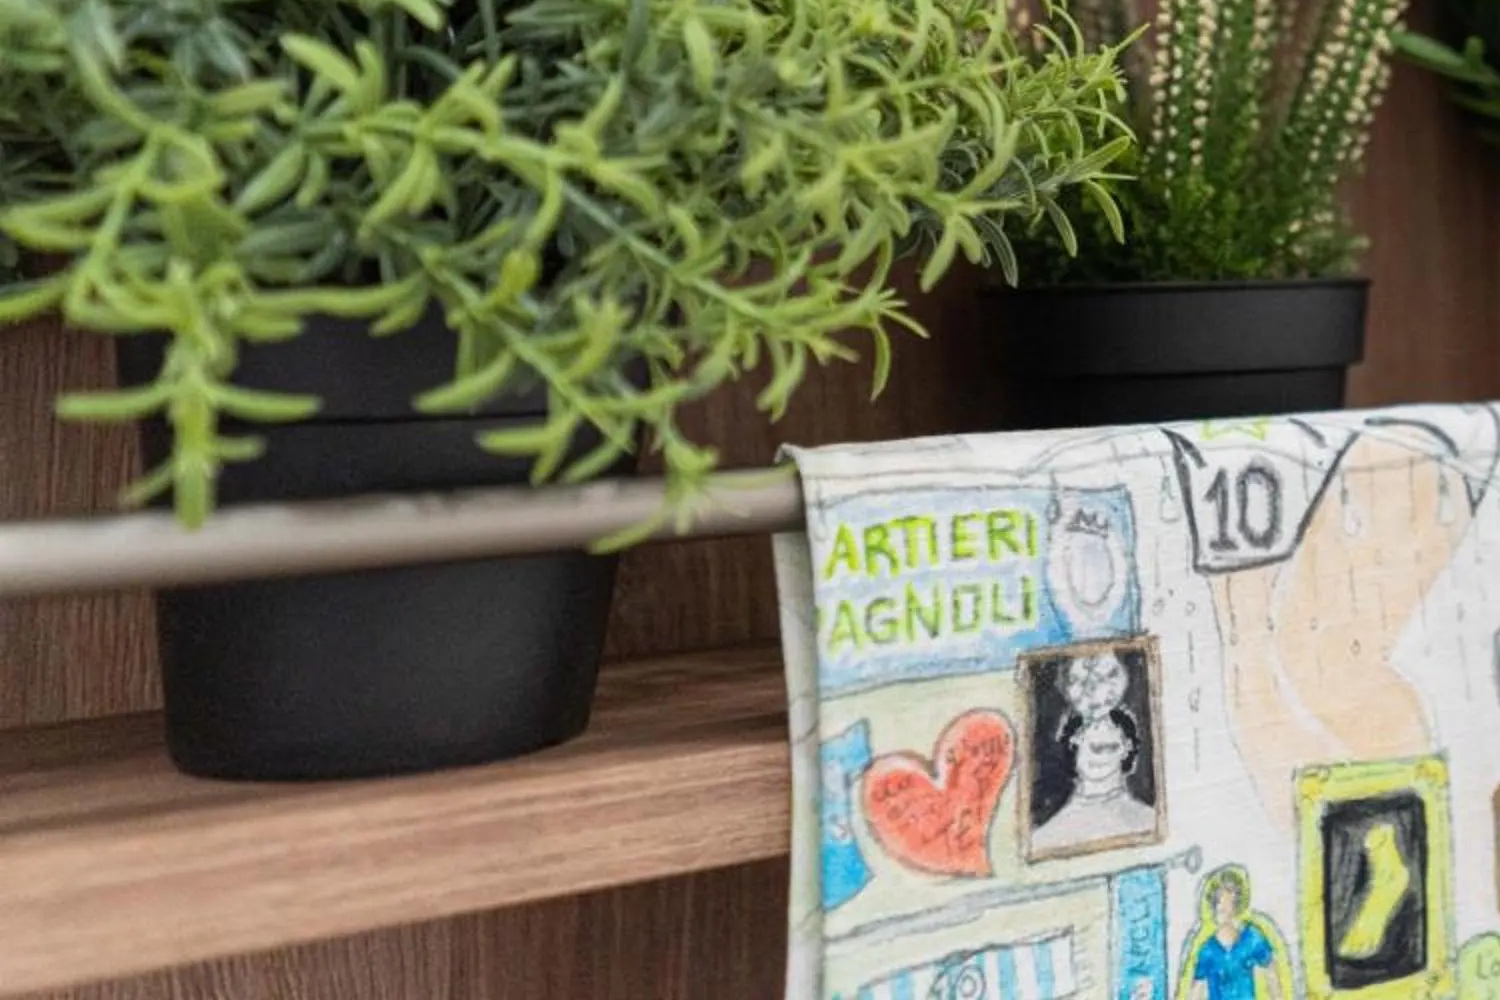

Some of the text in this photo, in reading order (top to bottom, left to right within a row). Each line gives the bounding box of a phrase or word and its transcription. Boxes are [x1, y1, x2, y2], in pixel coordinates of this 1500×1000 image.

[1203, 457, 1281, 550] 10
[823, 509, 1038, 580] ARTIERI
[816, 576, 1036, 653] AGNOLI
